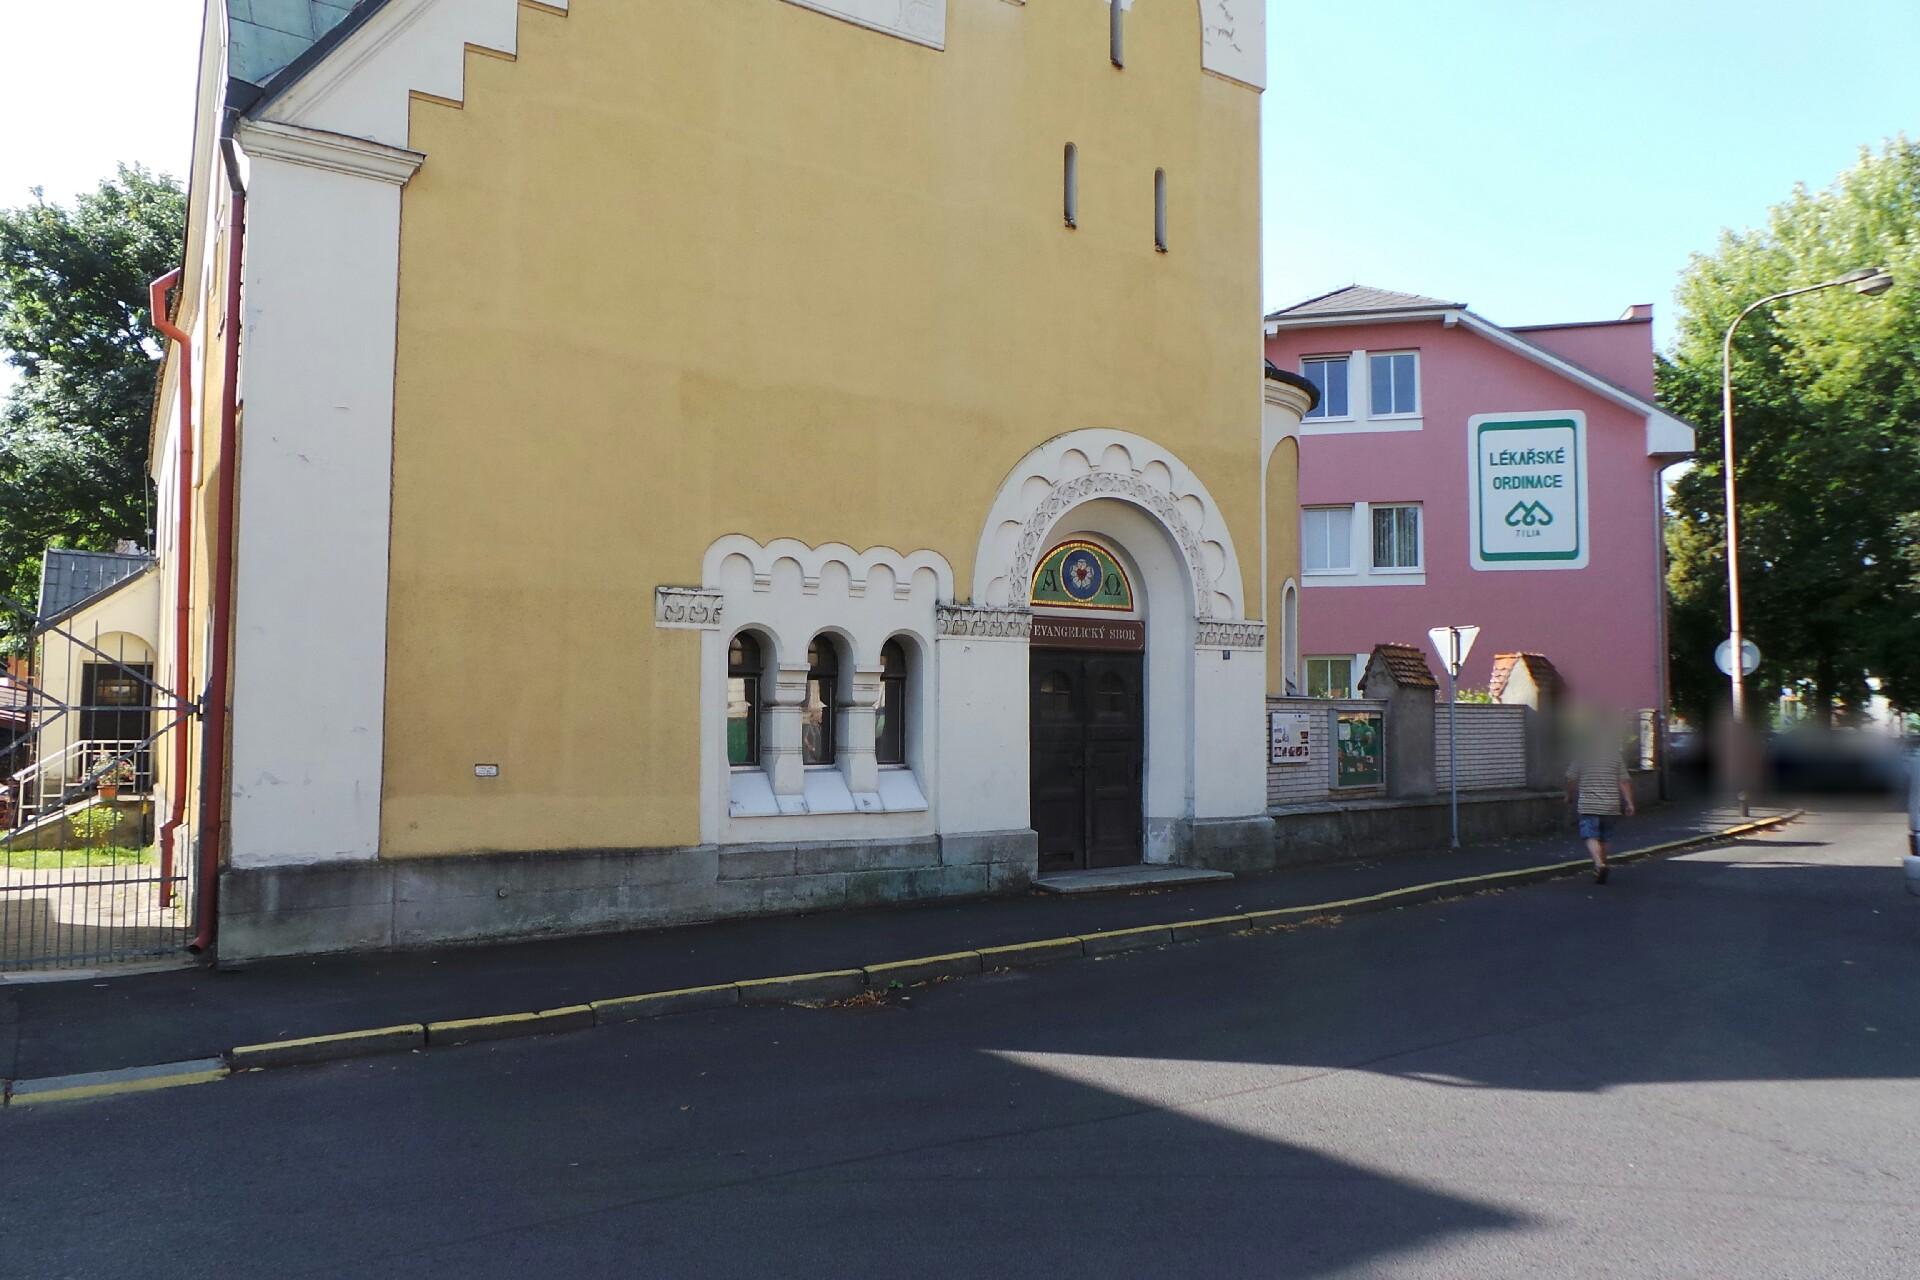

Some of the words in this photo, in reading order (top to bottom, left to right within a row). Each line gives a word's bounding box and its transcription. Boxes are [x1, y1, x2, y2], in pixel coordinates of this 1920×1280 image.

[1489, 447, 1565, 466] LÉKAŘSKÉ
[1493, 474, 1562, 490] ORDINACE
[1515, 529, 1540, 537] TILIA
[1033, 624, 1105, 639] EVANGELICKÝ
[1109, 629, 1136, 640] SBOR
